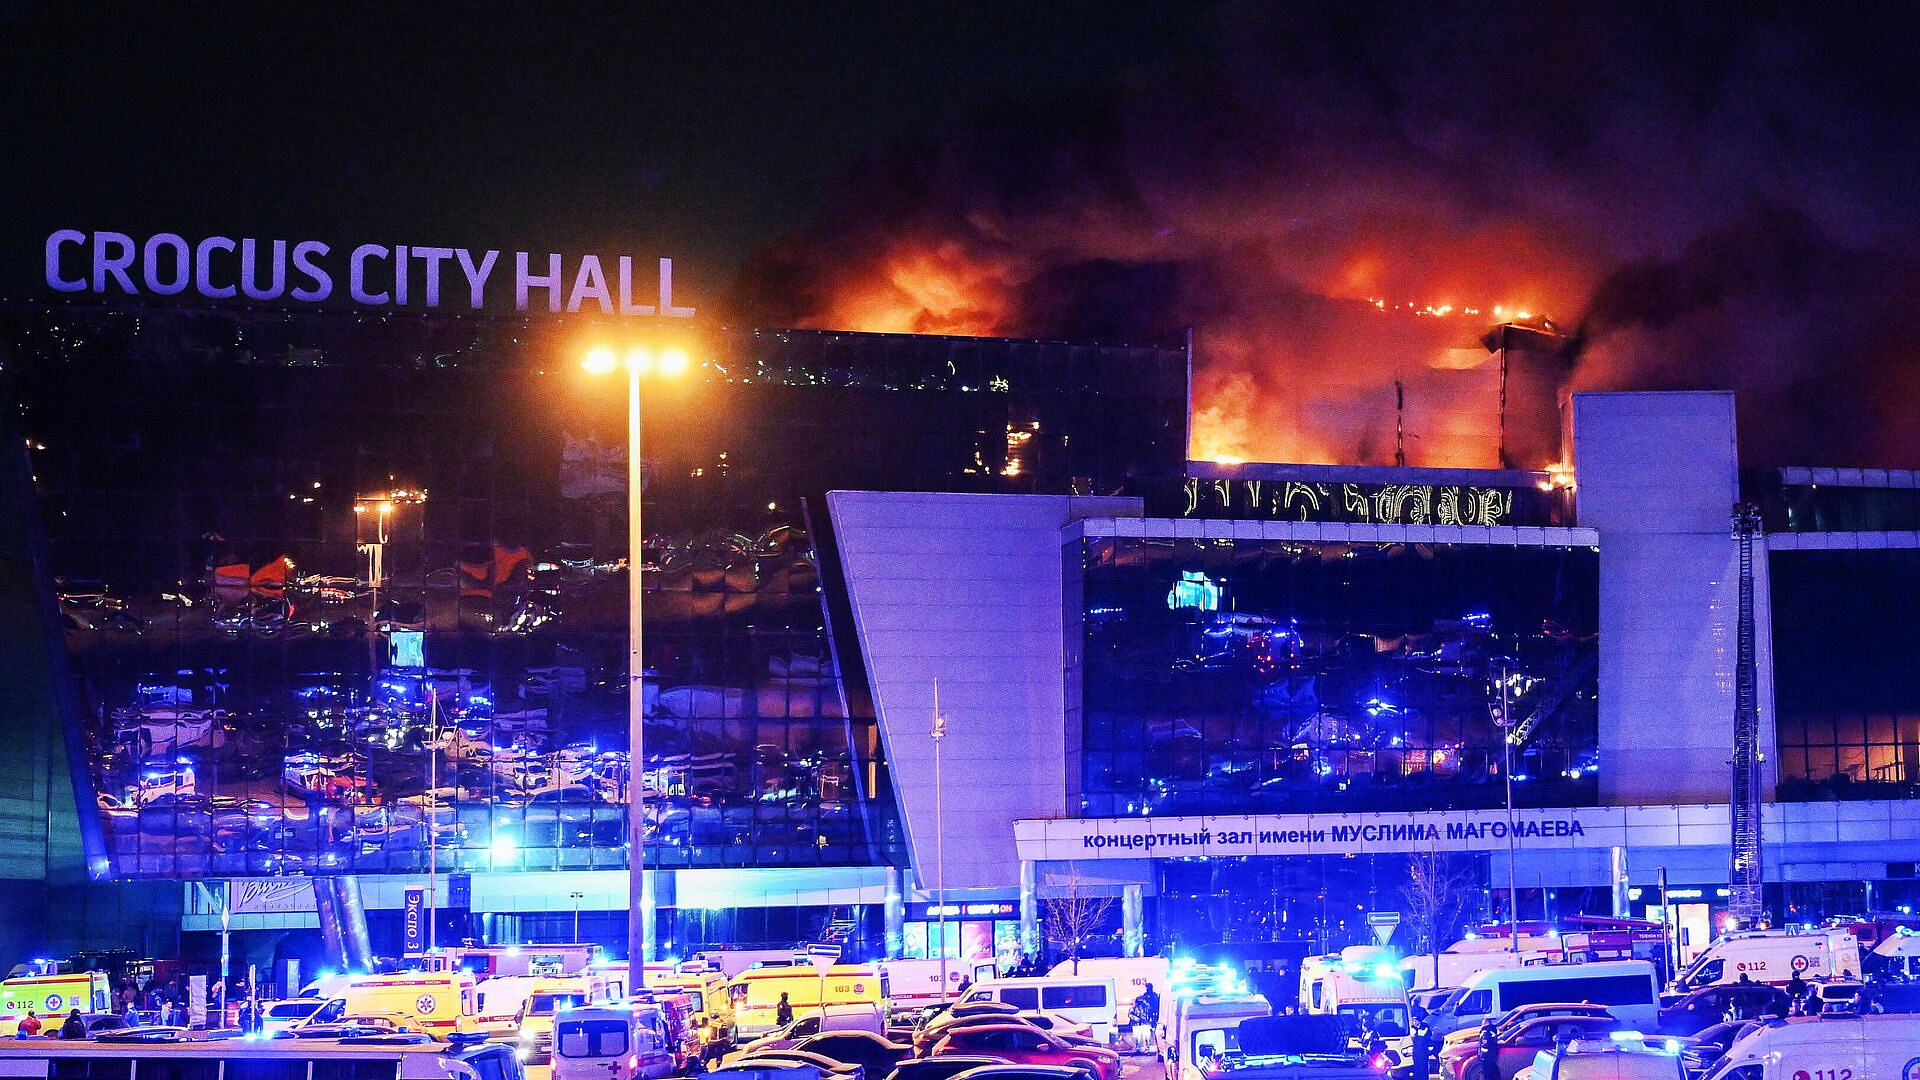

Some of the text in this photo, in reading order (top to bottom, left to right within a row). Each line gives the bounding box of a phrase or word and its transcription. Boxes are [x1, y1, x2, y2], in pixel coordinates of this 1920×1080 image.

[45, 229, 697, 318] CROCUS CITY HALL
[1083, 820, 1585, 850] концертный зал имени МУСЛИМА МАГОМАЕВА
[407, 941, 420, 949] 3
[1748, 962, 1766, 971] 112
[1131, 978, 1147, 986] 103
[834, 985, 850, 993] 103
[17, 1000, 34, 1009] 112
[1815, 1068, 1852, 1080] 112
